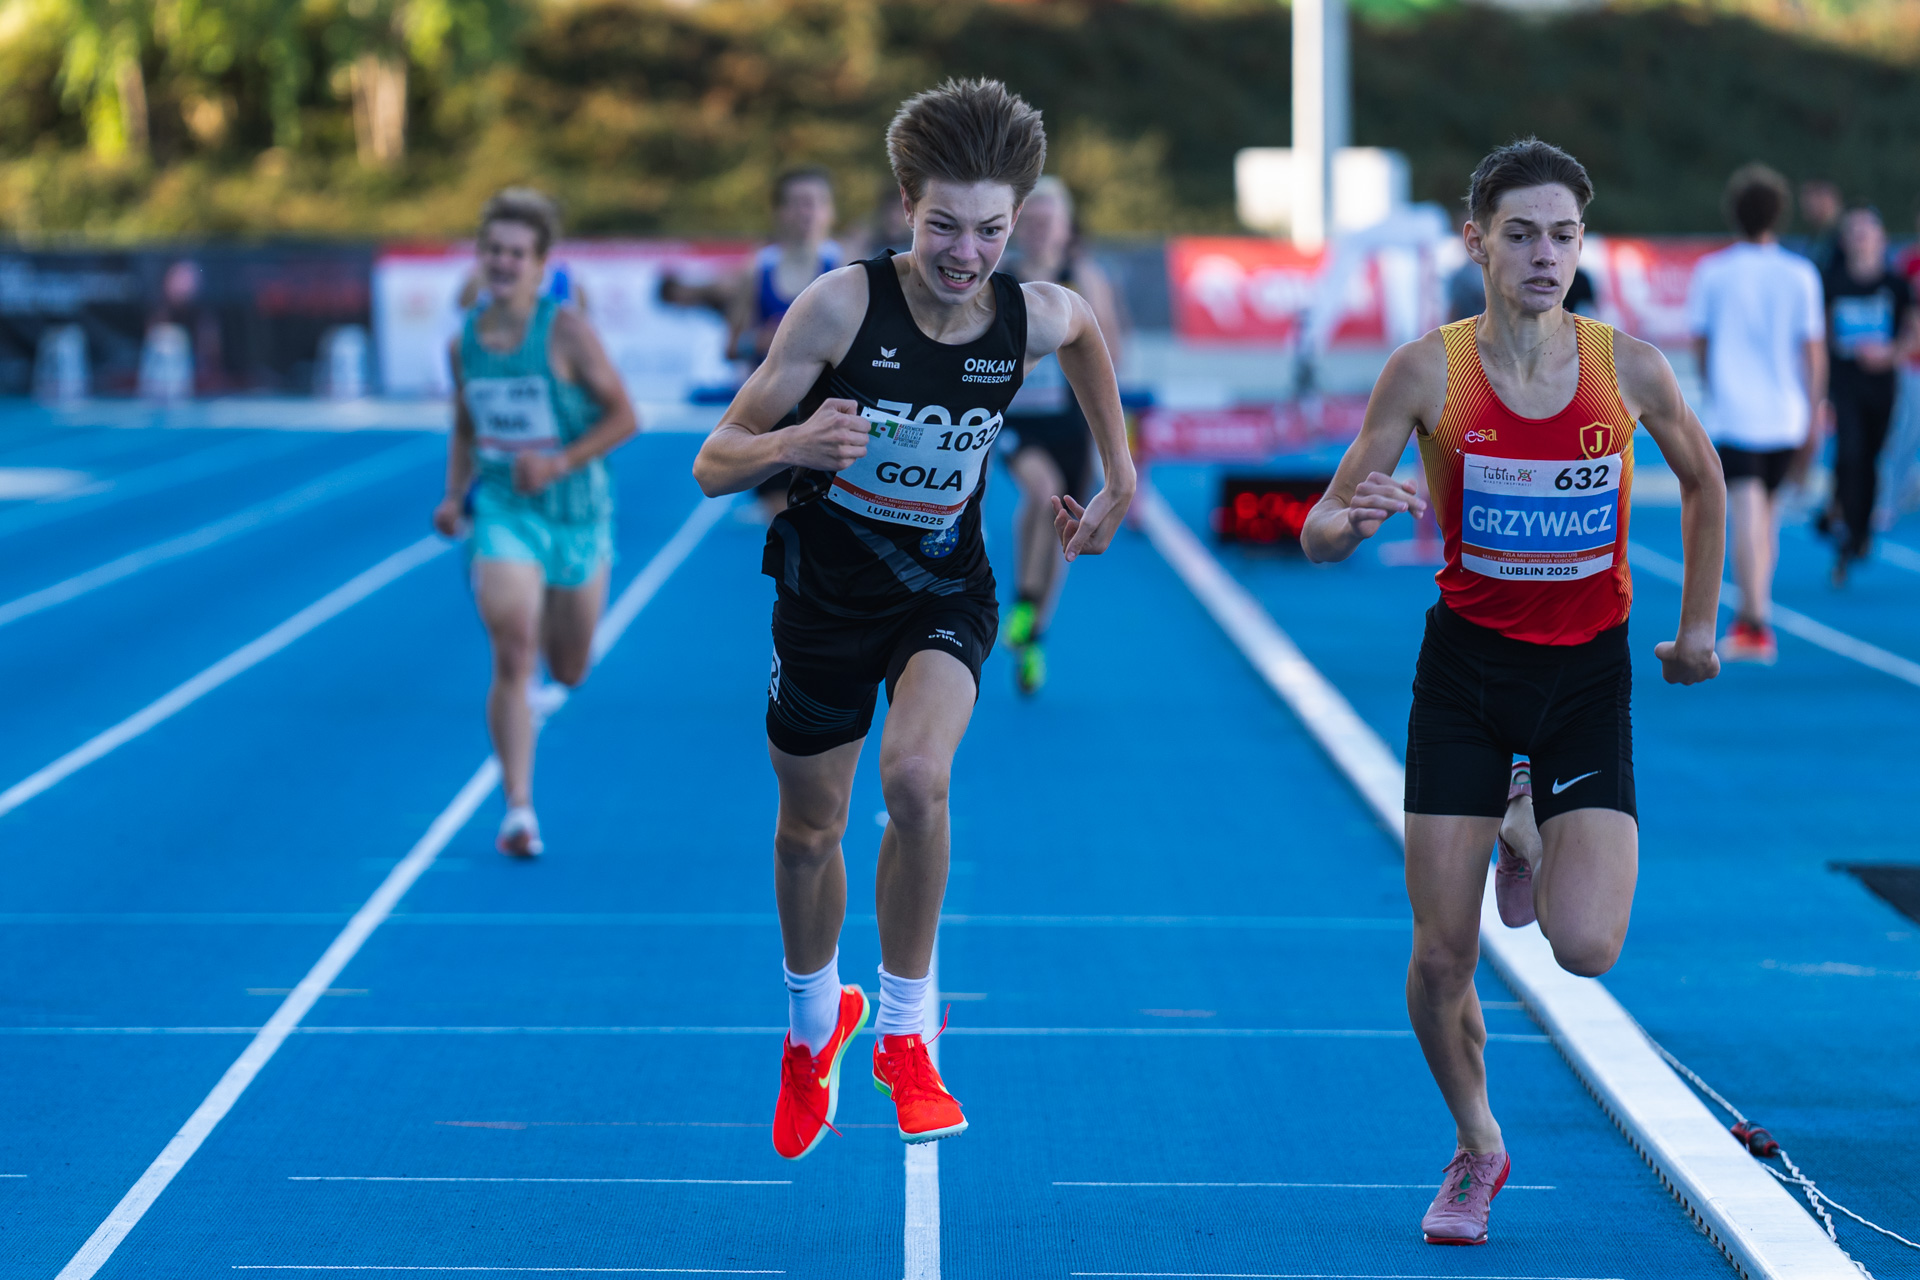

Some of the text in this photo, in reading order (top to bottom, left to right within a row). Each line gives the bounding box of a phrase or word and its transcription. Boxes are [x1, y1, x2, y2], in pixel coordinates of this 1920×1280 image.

[872, 359, 900, 369] erima
[964, 358, 1016, 373] ORKAN
[962, 374, 1012, 383] OSTRZESZÓW
[1465, 428, 1498, 443] esa
[1589, 430, 1605, 453] J
[875, 461, 963, 492] GOLA
[1554, 465, 1610, 491] 632
[866, 505, 944, 525] LUBLIN 2025
[1468, 504, 1613, 537] GRZYWACZ
[1500, 565, 1579, 576] LUBLIN 2025
